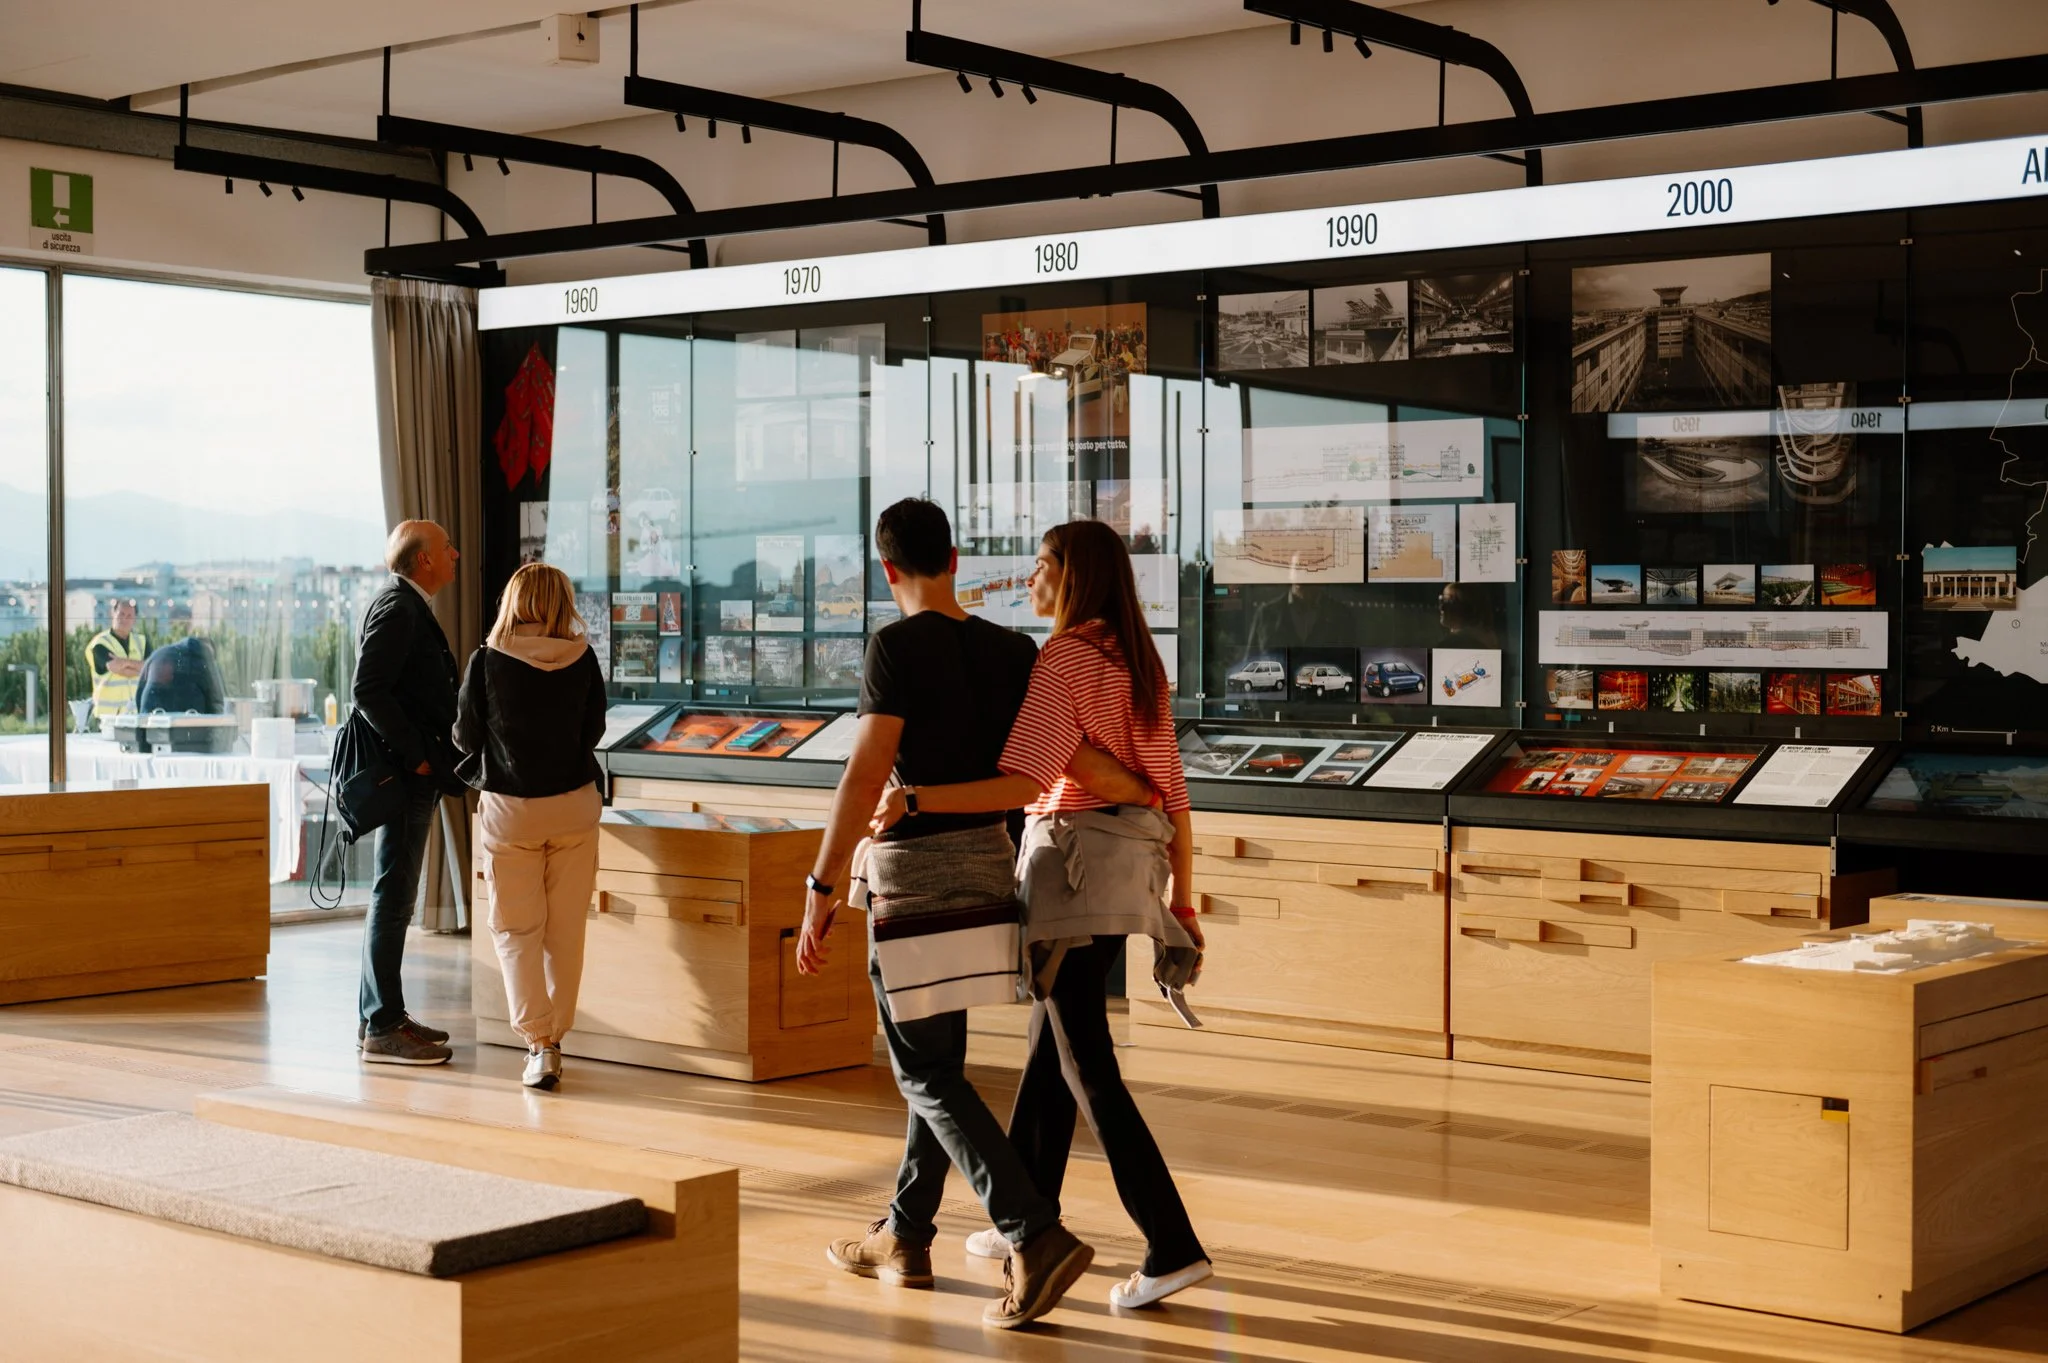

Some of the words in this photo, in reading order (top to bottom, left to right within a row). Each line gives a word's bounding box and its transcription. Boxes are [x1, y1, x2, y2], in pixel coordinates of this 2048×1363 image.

[2021, 146, 2048, 185] A
[1666, 178, 1733, 217] 2000
[51, 232, 72, 242] uscita
[1326, 213, 1378, 248] 1990
[42, 240, 49, 249] di
[50, 241, 81, 253] sicurezza
[1034, 241, 1078, 273] 1980
[783, 265, 821, 295] 1970
[564, 286, 598, 314] 1960
[1075, 440, 1095, 452] posto
[1095, 441, 1107, 452] per
[1107, 439, 1128, 450] tutto.
[1930, 725, 1936, 733] 2
